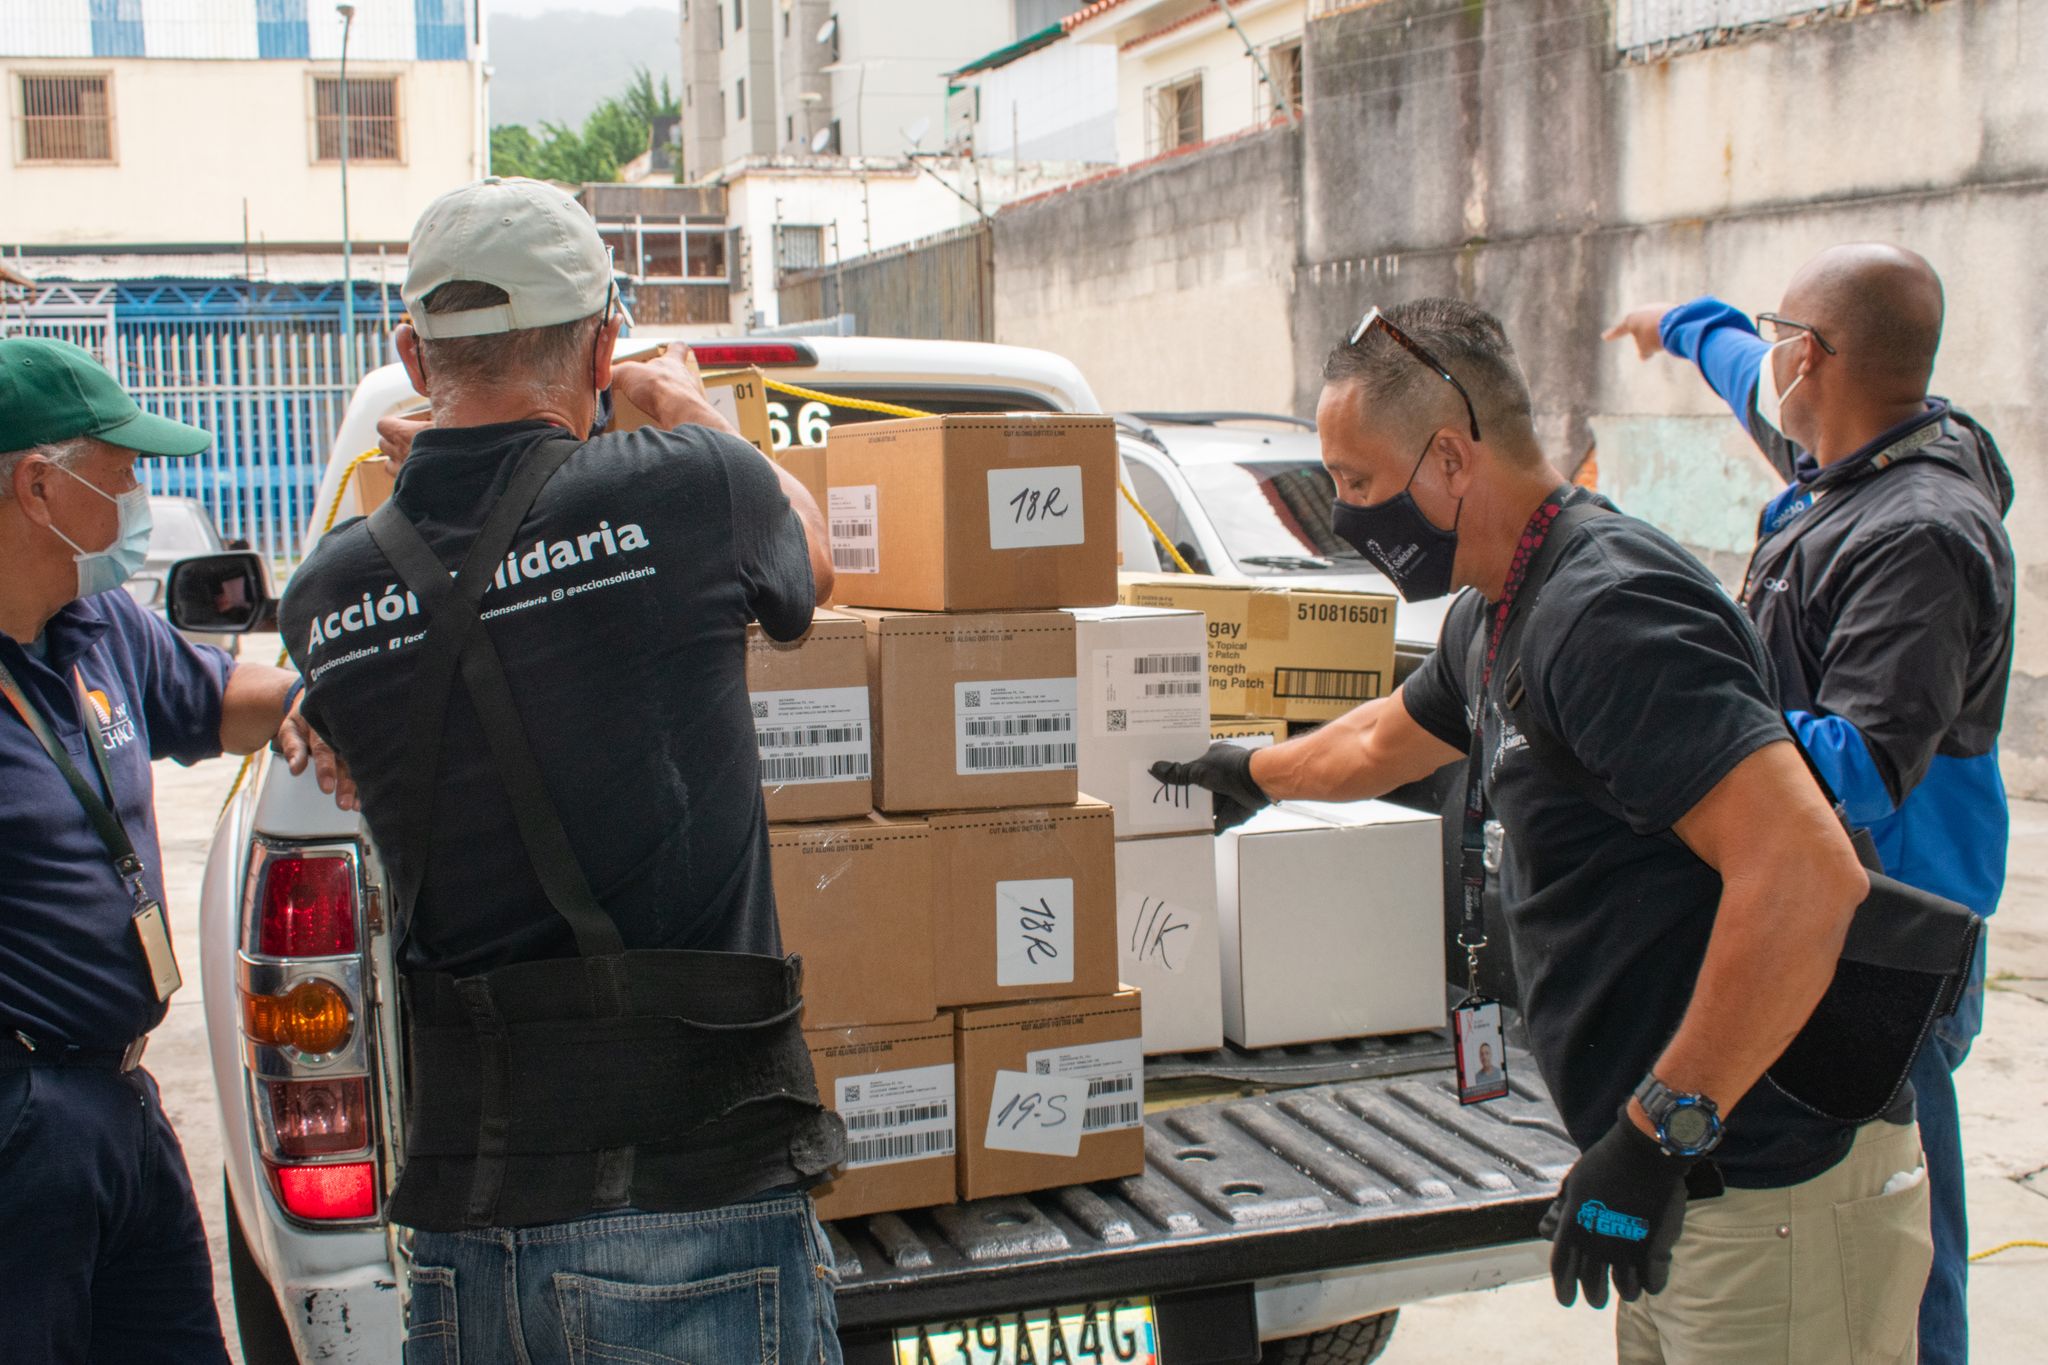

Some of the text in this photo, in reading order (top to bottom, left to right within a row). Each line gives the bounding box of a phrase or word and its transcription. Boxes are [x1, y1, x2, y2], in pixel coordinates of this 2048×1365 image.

[734, 383, 754, 400] 01
[1010, 486, 1068, 524] 18R
[485, 520, 651, 593] lidaria
[404, 629, 428, 646] face
[480, 594, 547, 621] ccionsolidaria
[566, 566, 656, 597] @accionsolidaria
[1297, 603, 1388, 624] 510816501
[1207, 620, 1241, 638] gay
[1215, 641, 1248, 652] Topical
[1215, 651, 1240, 659] Patch
[1208, 664, 1246, 676] rength
[1209, 677, 1264, 690] ing Patch
[1597, 1216, 1648, 1241] GRIP
